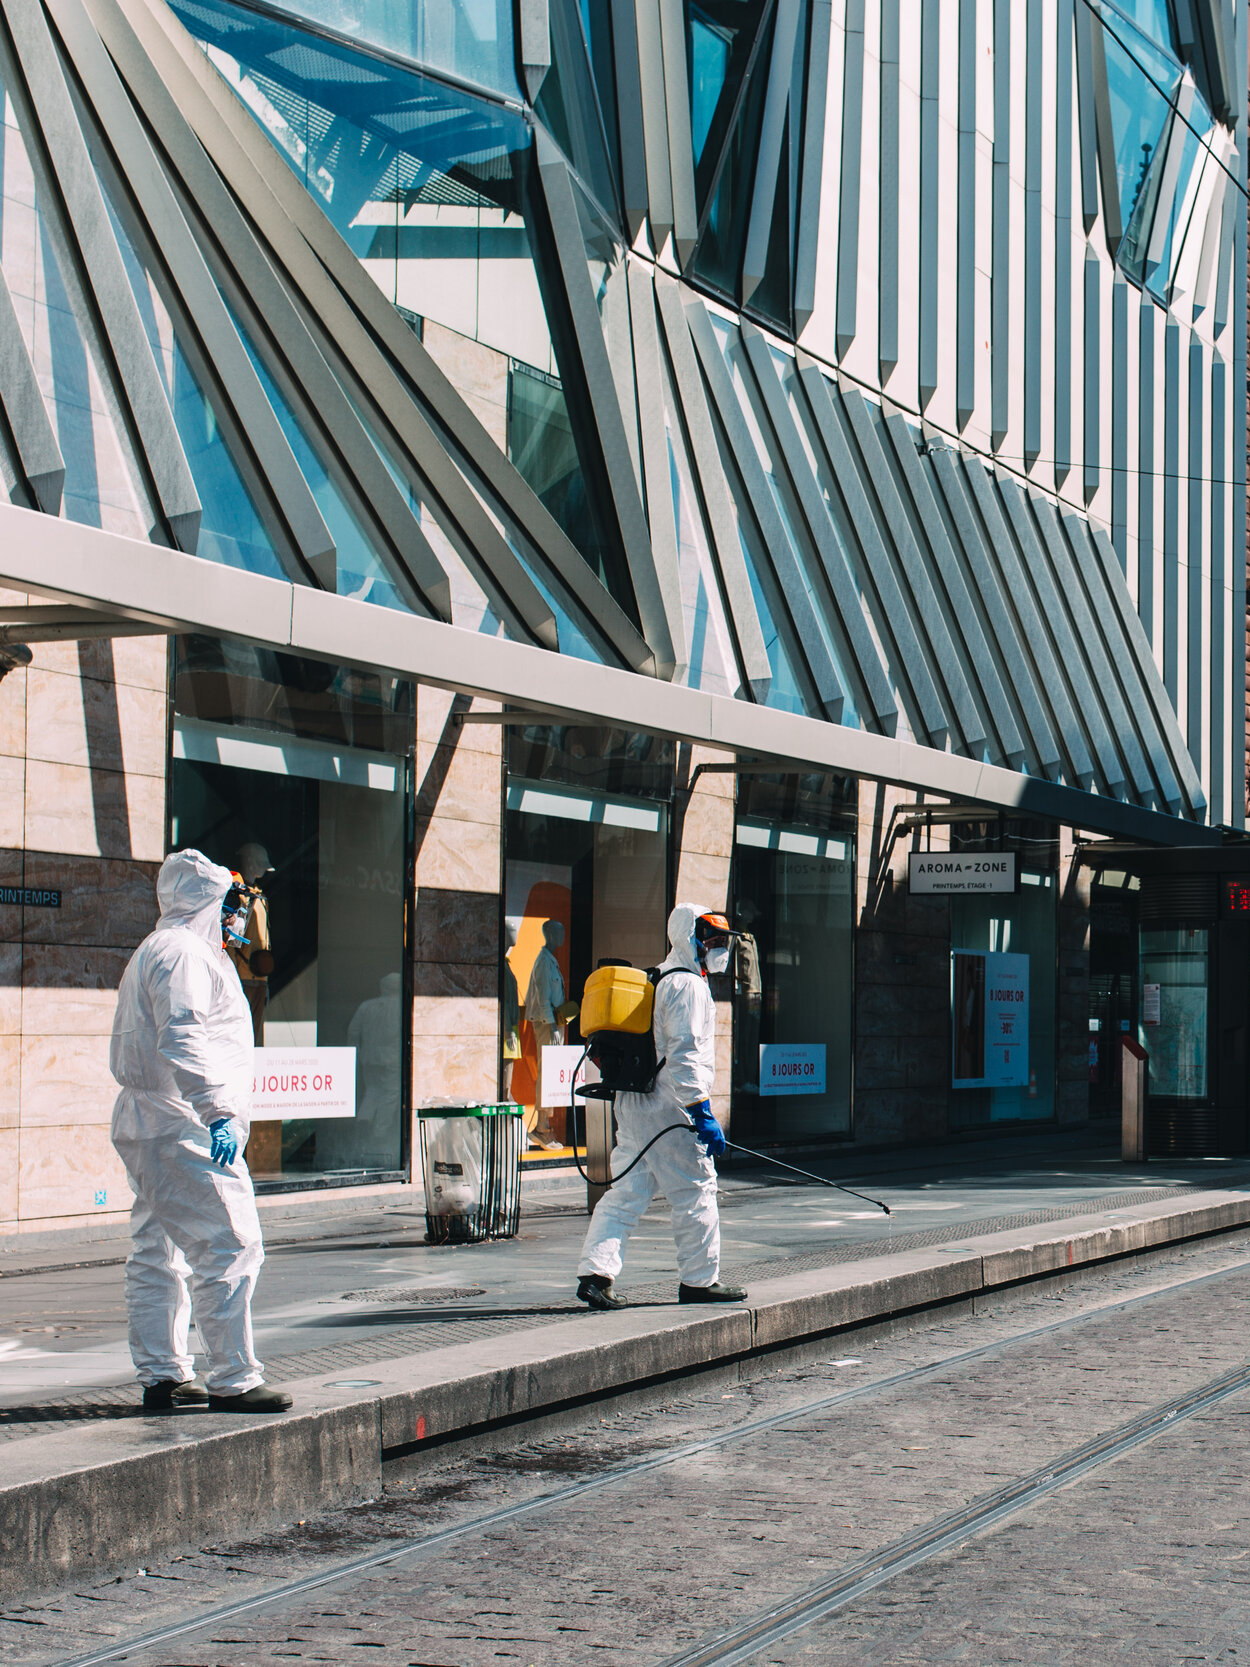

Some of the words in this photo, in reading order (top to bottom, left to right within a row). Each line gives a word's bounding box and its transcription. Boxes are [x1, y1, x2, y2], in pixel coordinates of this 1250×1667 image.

[918, 863, 962, 873] AROMA
[974, 862, 1007, 873] ZONE
[559, 1069, 565, 1083] 8
[771, 1063, 777, 1076] 8
[778, 1063, 802, 1076] JOURS
[803, 1063, 815, 1076] OR
[261, 1075, 307, 1092] JOURS
[312, 1075, 333, 1091] OR
